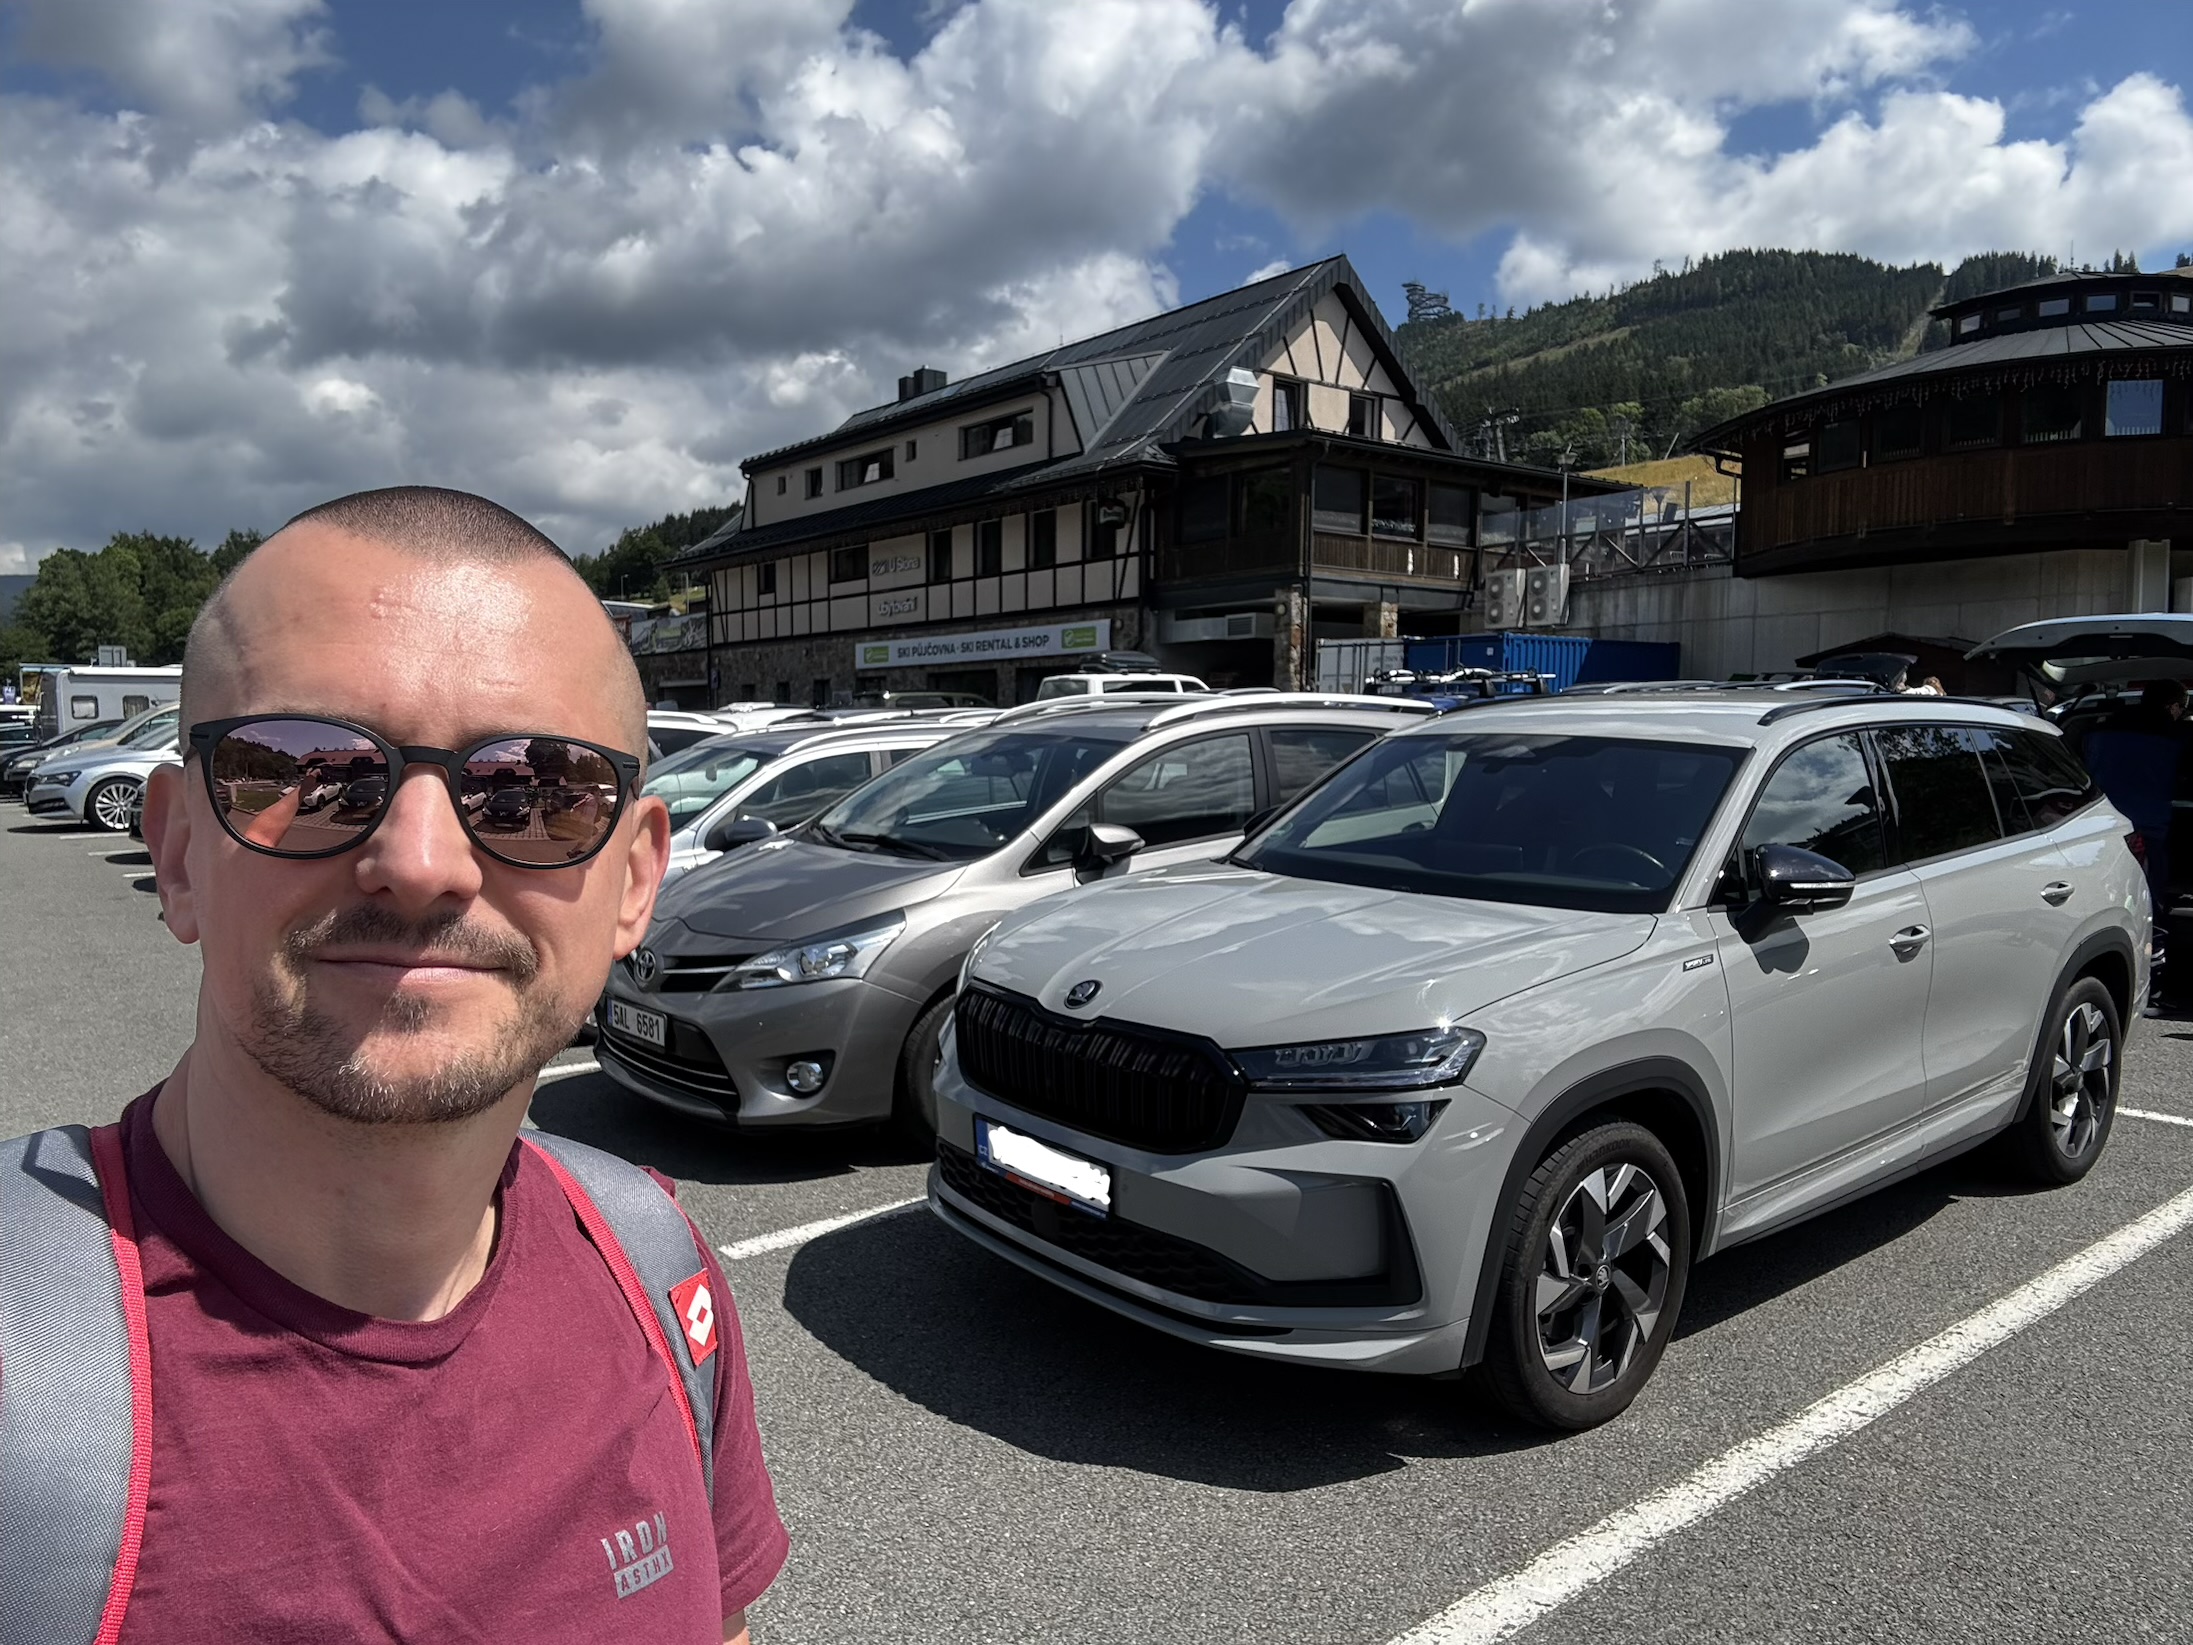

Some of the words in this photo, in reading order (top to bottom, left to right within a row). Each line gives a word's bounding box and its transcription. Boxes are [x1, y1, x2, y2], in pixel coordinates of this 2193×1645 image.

[897, 647, 911, 658] SKI
[961, 643, 975, 654] SKI
[975, 638, 1012, 653] RENTAL
[1015, 638, 1021, 649] &
[1022, 634, 1050, 649] SHOP
[613, 1005, 630, 1030] 5AL
[636, 1013, 660, 1040] 6581
[600, 1510, 667, 1571] IRON
